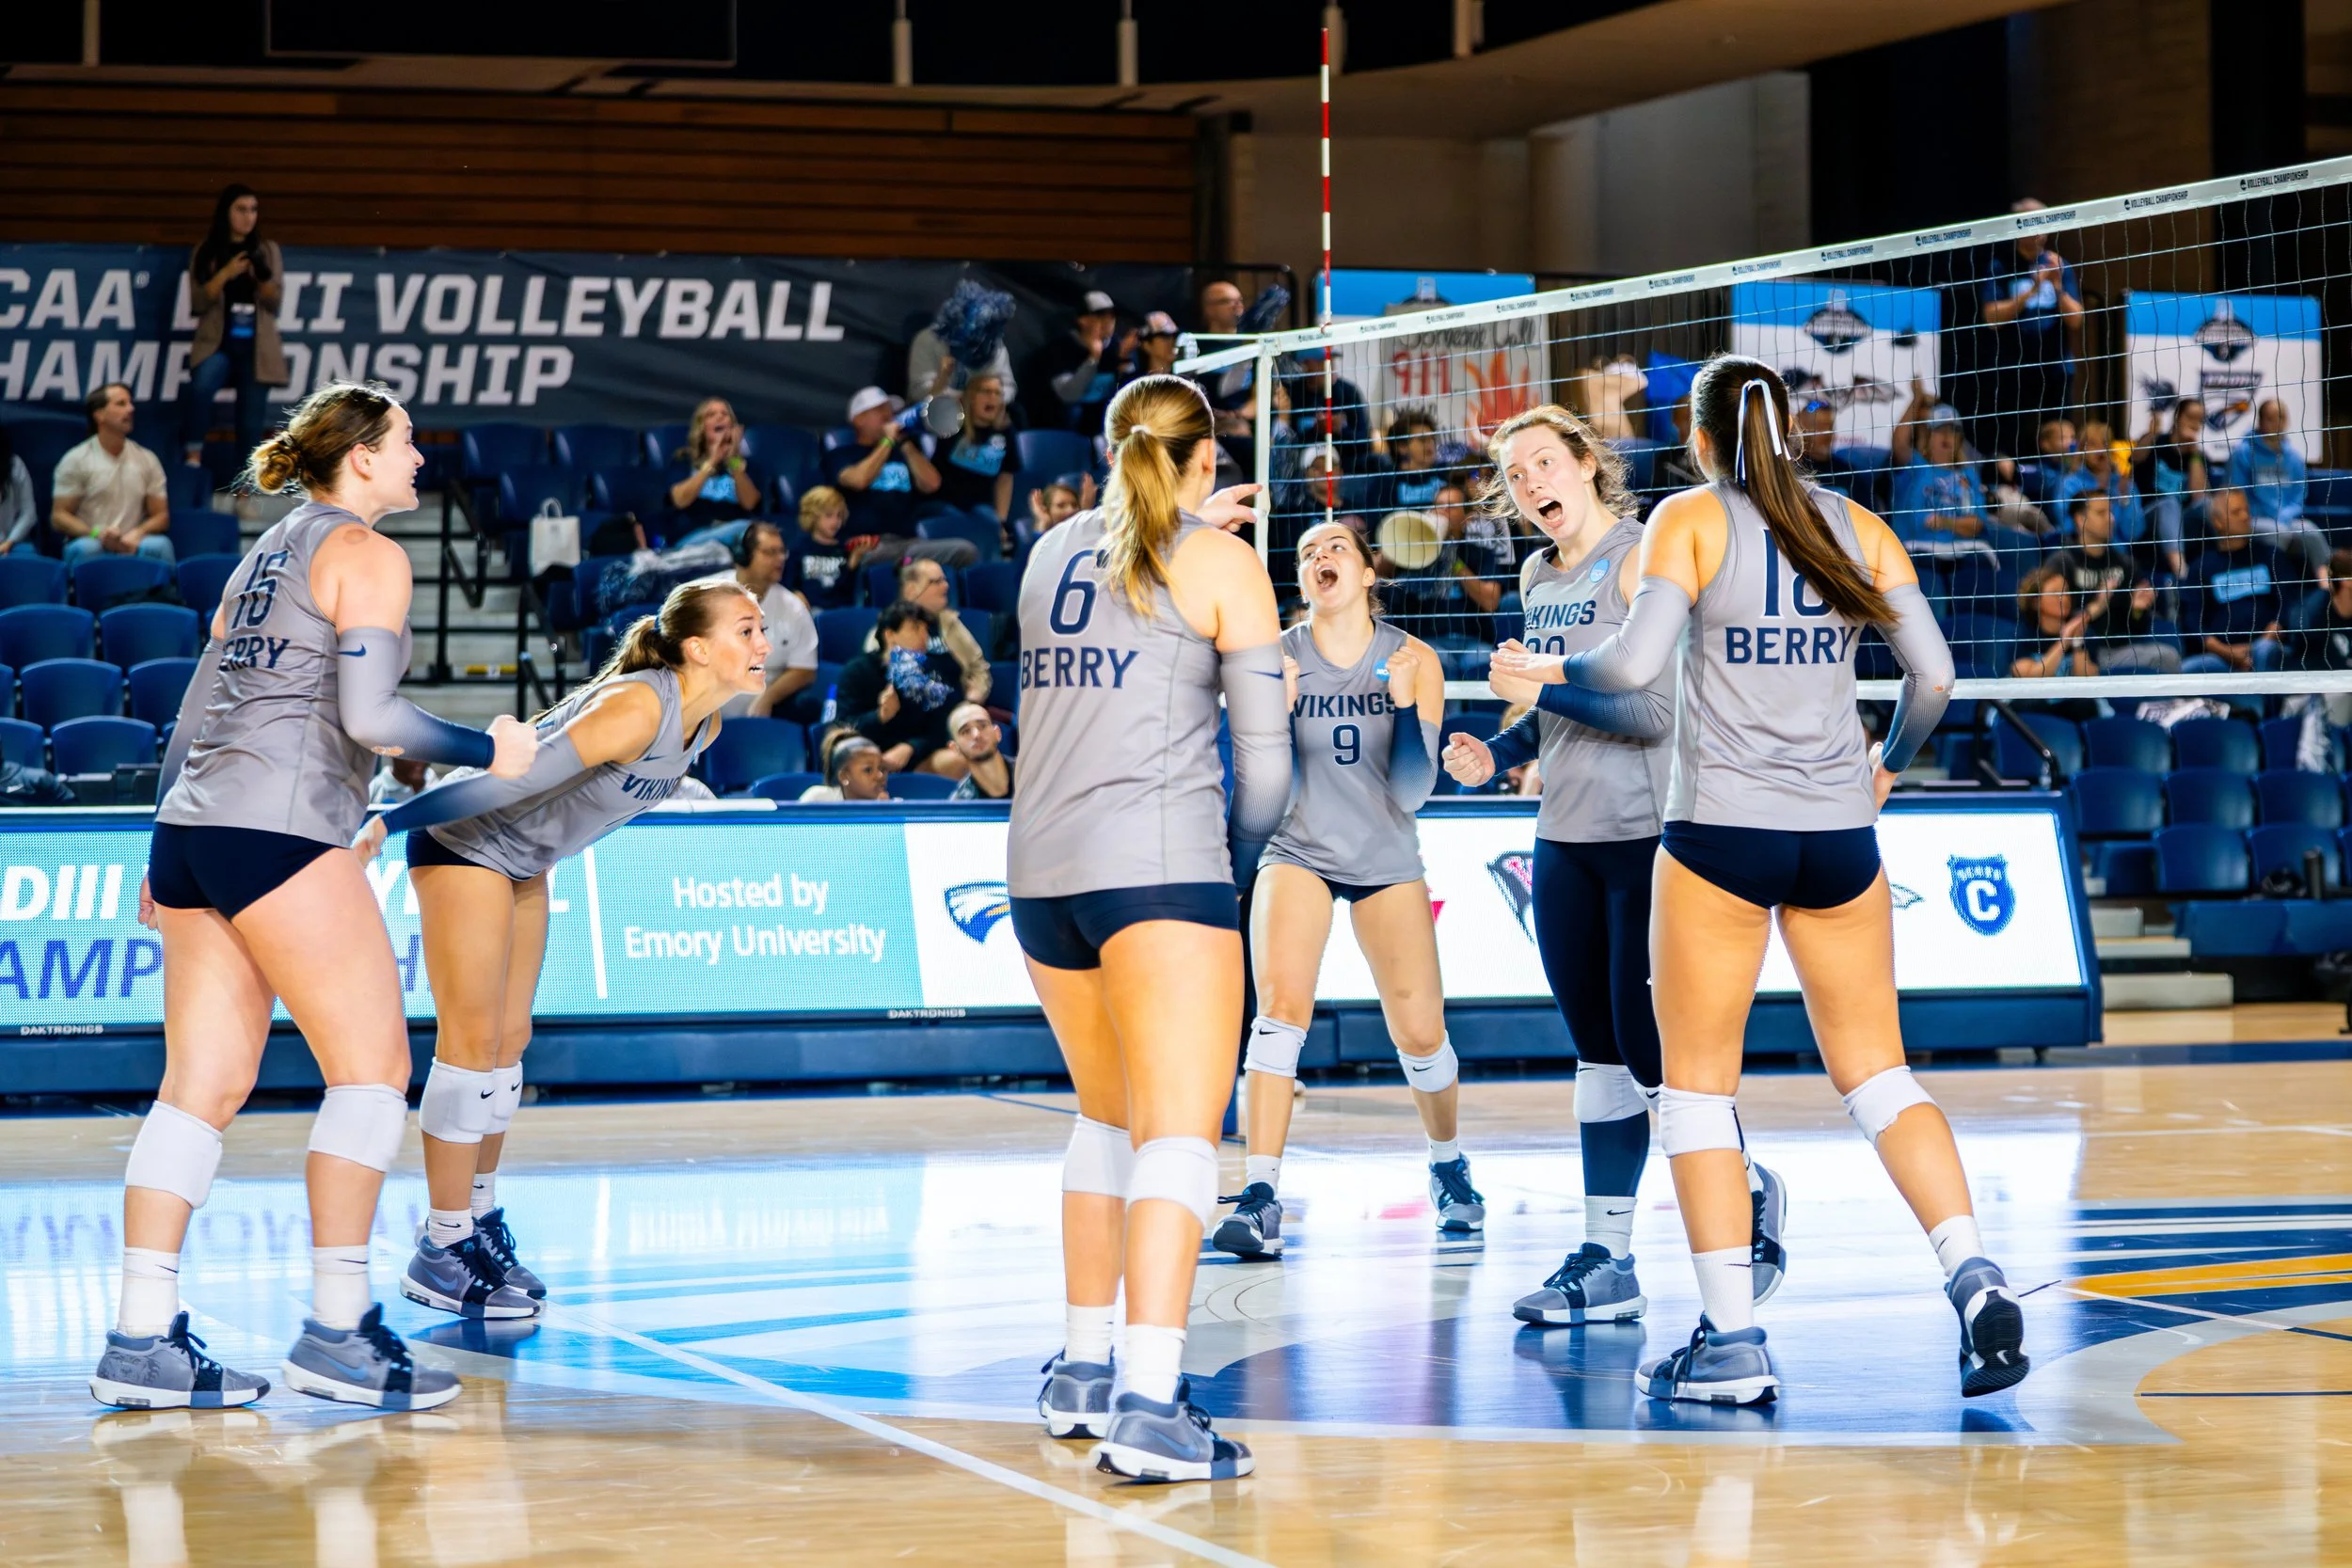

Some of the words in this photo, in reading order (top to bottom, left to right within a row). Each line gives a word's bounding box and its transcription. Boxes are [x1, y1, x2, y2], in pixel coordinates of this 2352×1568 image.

[2130, 195, 2155, 209] VOLLEYBALL
[2155, 190, 2189, 204] CHAMPIONSHIP
[2247, 175, 2274, 189] VOLLEYBALL
[2273, 169, 2310, 184] CHAMPIONSHIP
[2022, 214, 2046, 229] VOLLEYBALL
[2045, 210, 2076, 223] CHAMPIONSHIP
[376, 273, 845, 341] VOLLEYBALL
[1049, 548, 1111, 637] 6
[1724, 626, 1859, 665] BERRY
[1021, 645, 1140, 691] BERRY
[1332, 723, 1362, 766] 9
[673, 874, 783, 909] Hosted
[791, 873, 829, 915] by
[1965, 879, 2001, 921] C
[625, 927, 723, 965] Emory
[731, 924, 886, 963] University
[20, 1024, 104, 1036] DAKTRONICS
[888, 1009, 966, 1020] DAKTRONICS
